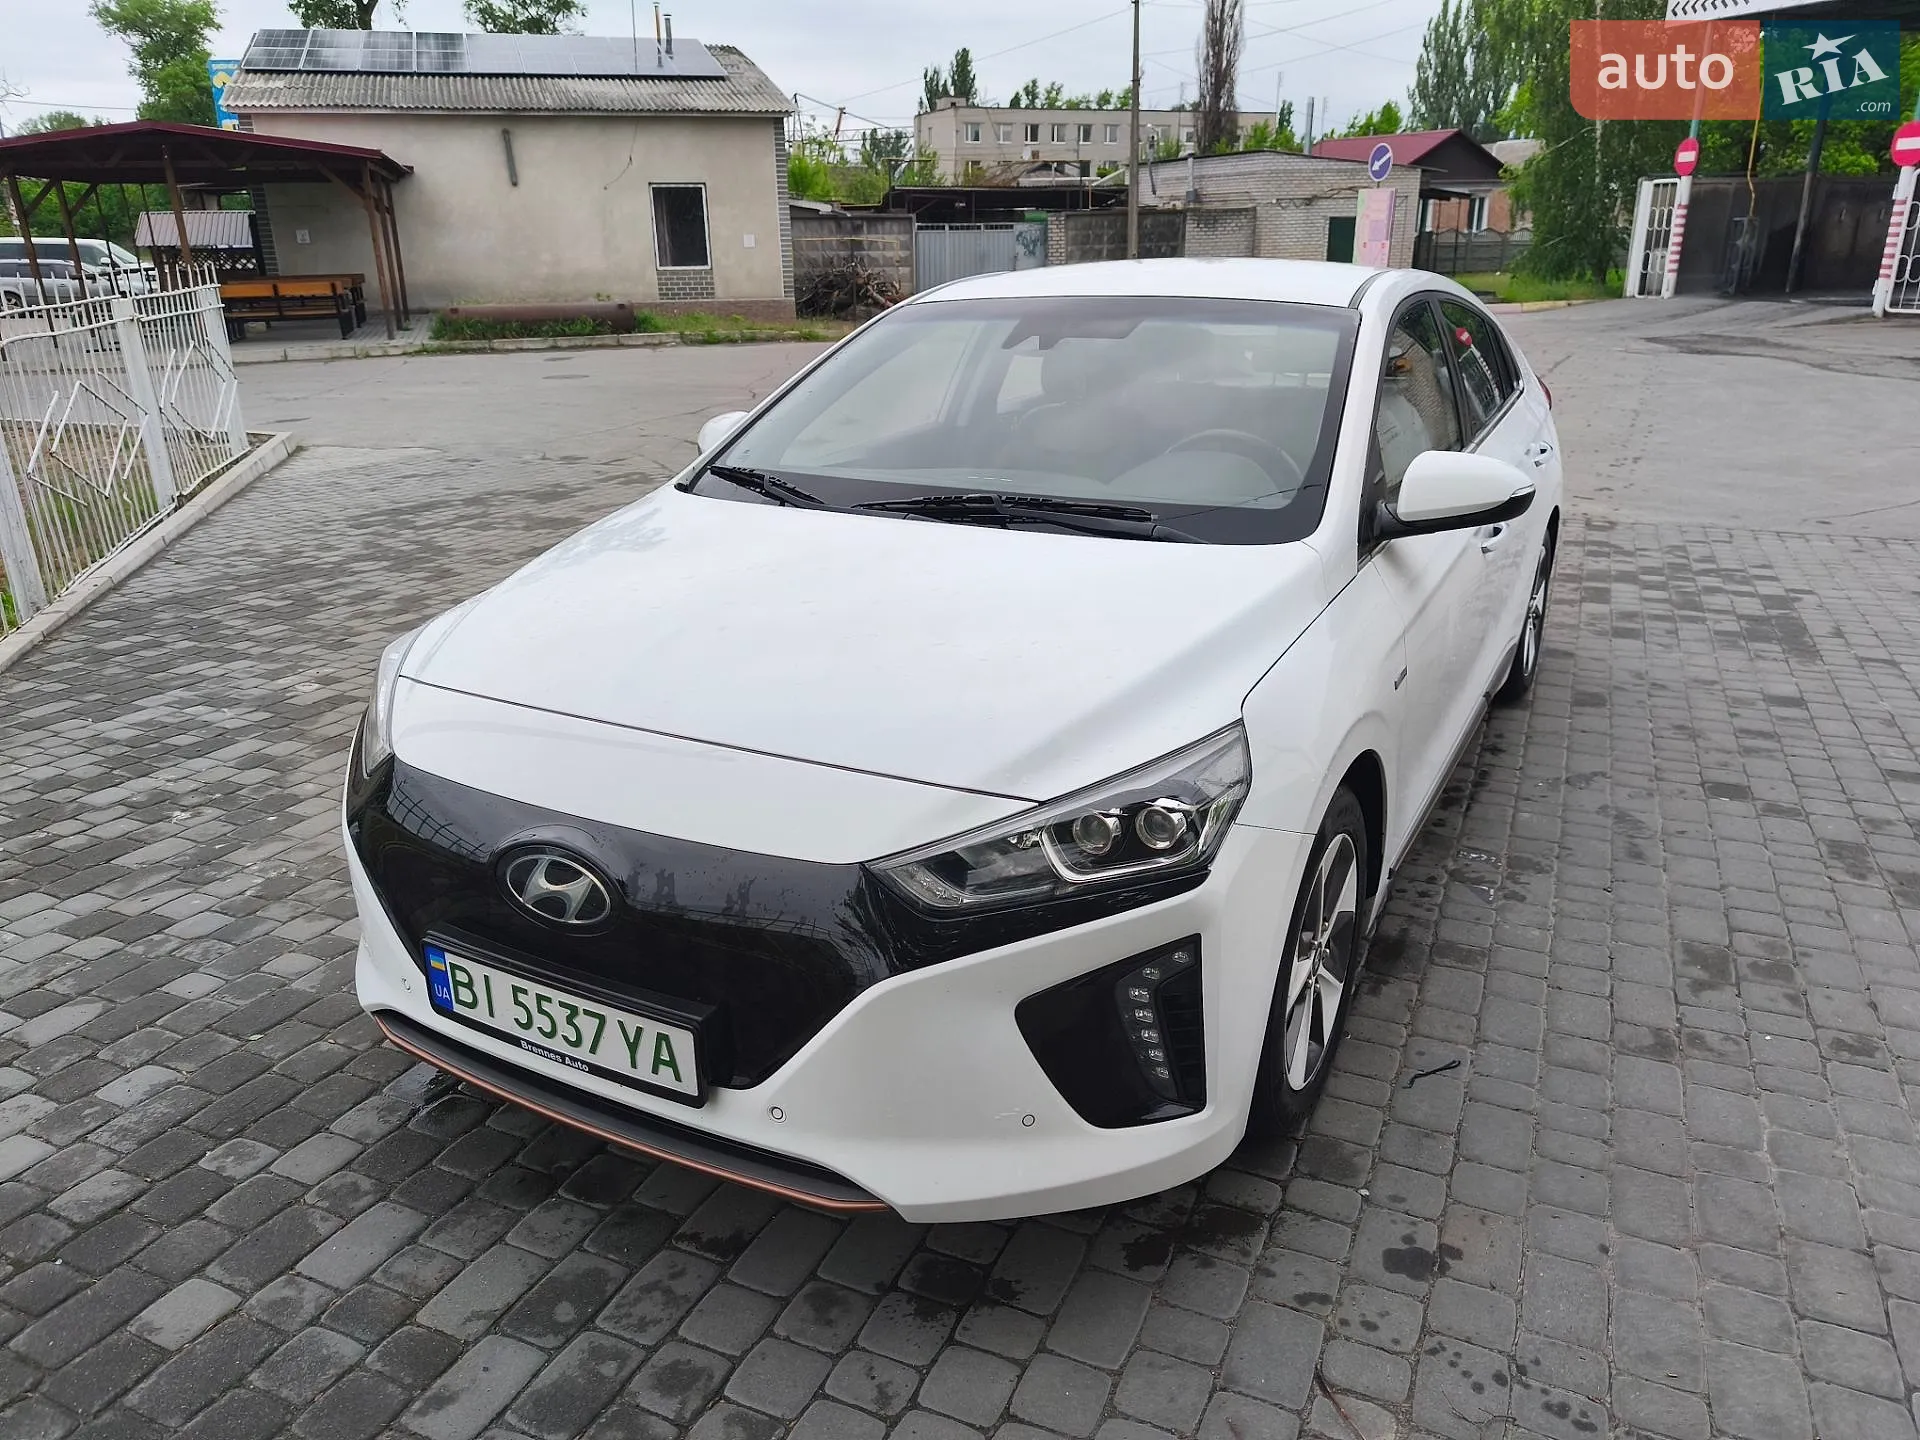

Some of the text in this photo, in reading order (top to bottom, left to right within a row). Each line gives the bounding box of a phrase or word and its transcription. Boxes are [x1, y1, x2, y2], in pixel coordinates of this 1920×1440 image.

[435, 984, 450, 1000] UA
[449, 962, 682, 1082] BI 5537 YA
[520, 1040, 589, 1072] Brennes Auto
